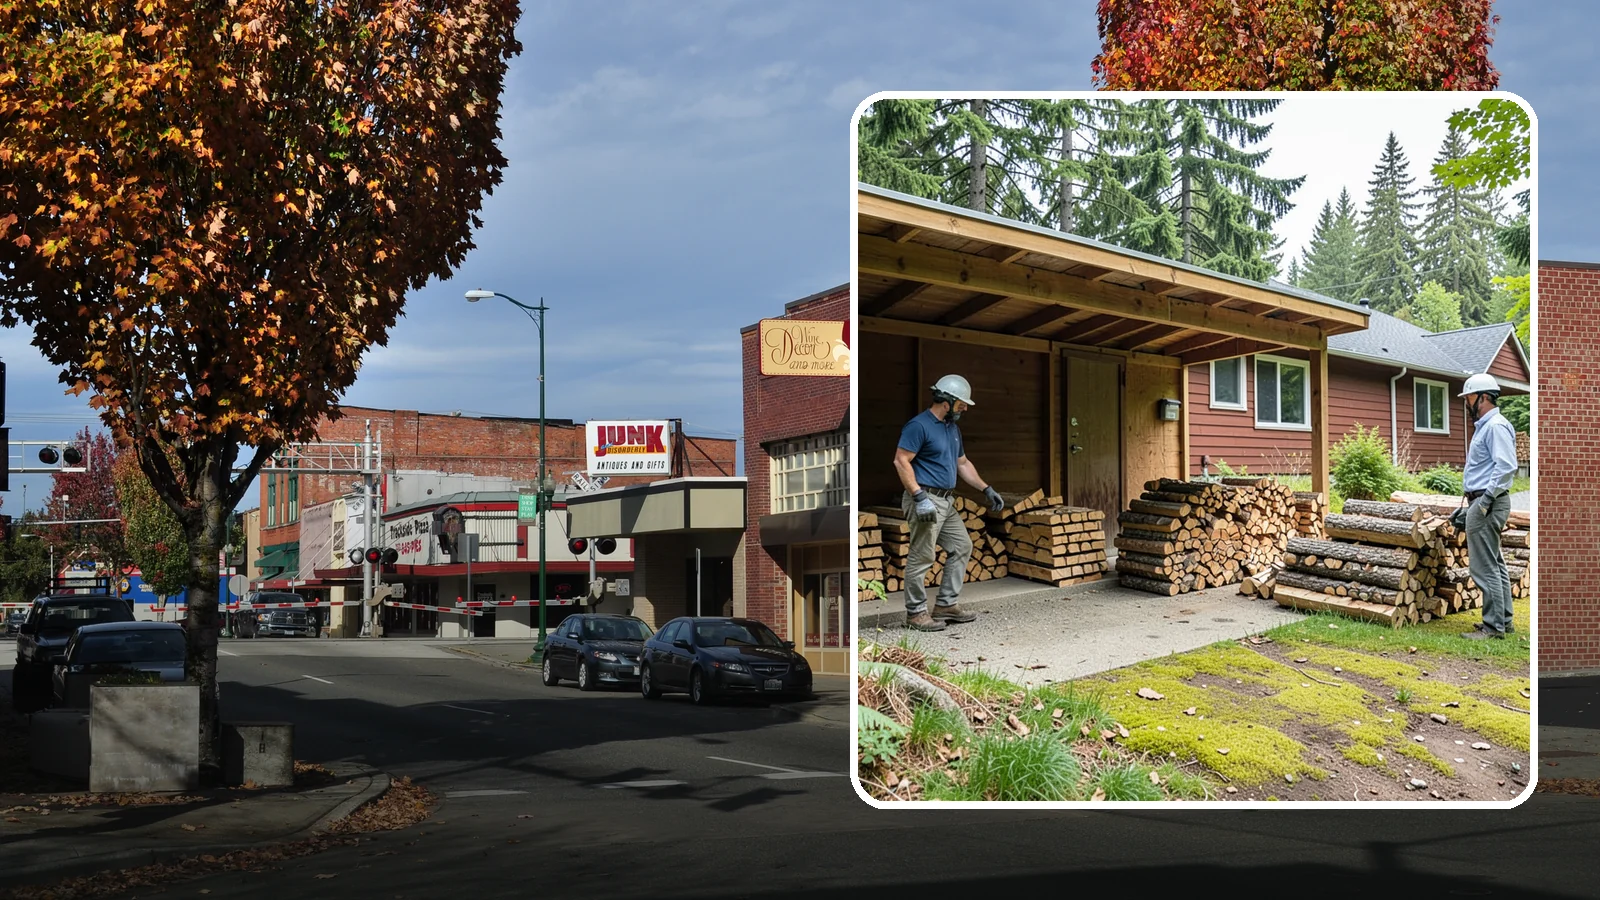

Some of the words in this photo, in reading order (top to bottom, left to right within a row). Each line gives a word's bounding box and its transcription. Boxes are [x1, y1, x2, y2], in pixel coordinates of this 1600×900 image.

[595, 425, 665, 457] JUNK
[607, 446, 646, 454] DISORDERLY
[597, 461, 628, 470] ANTIQUES
[631, 461, 644, 470] AND
[647, 460, 665, 470] GIFTS
[414, 520, 429, 534] Pizza
